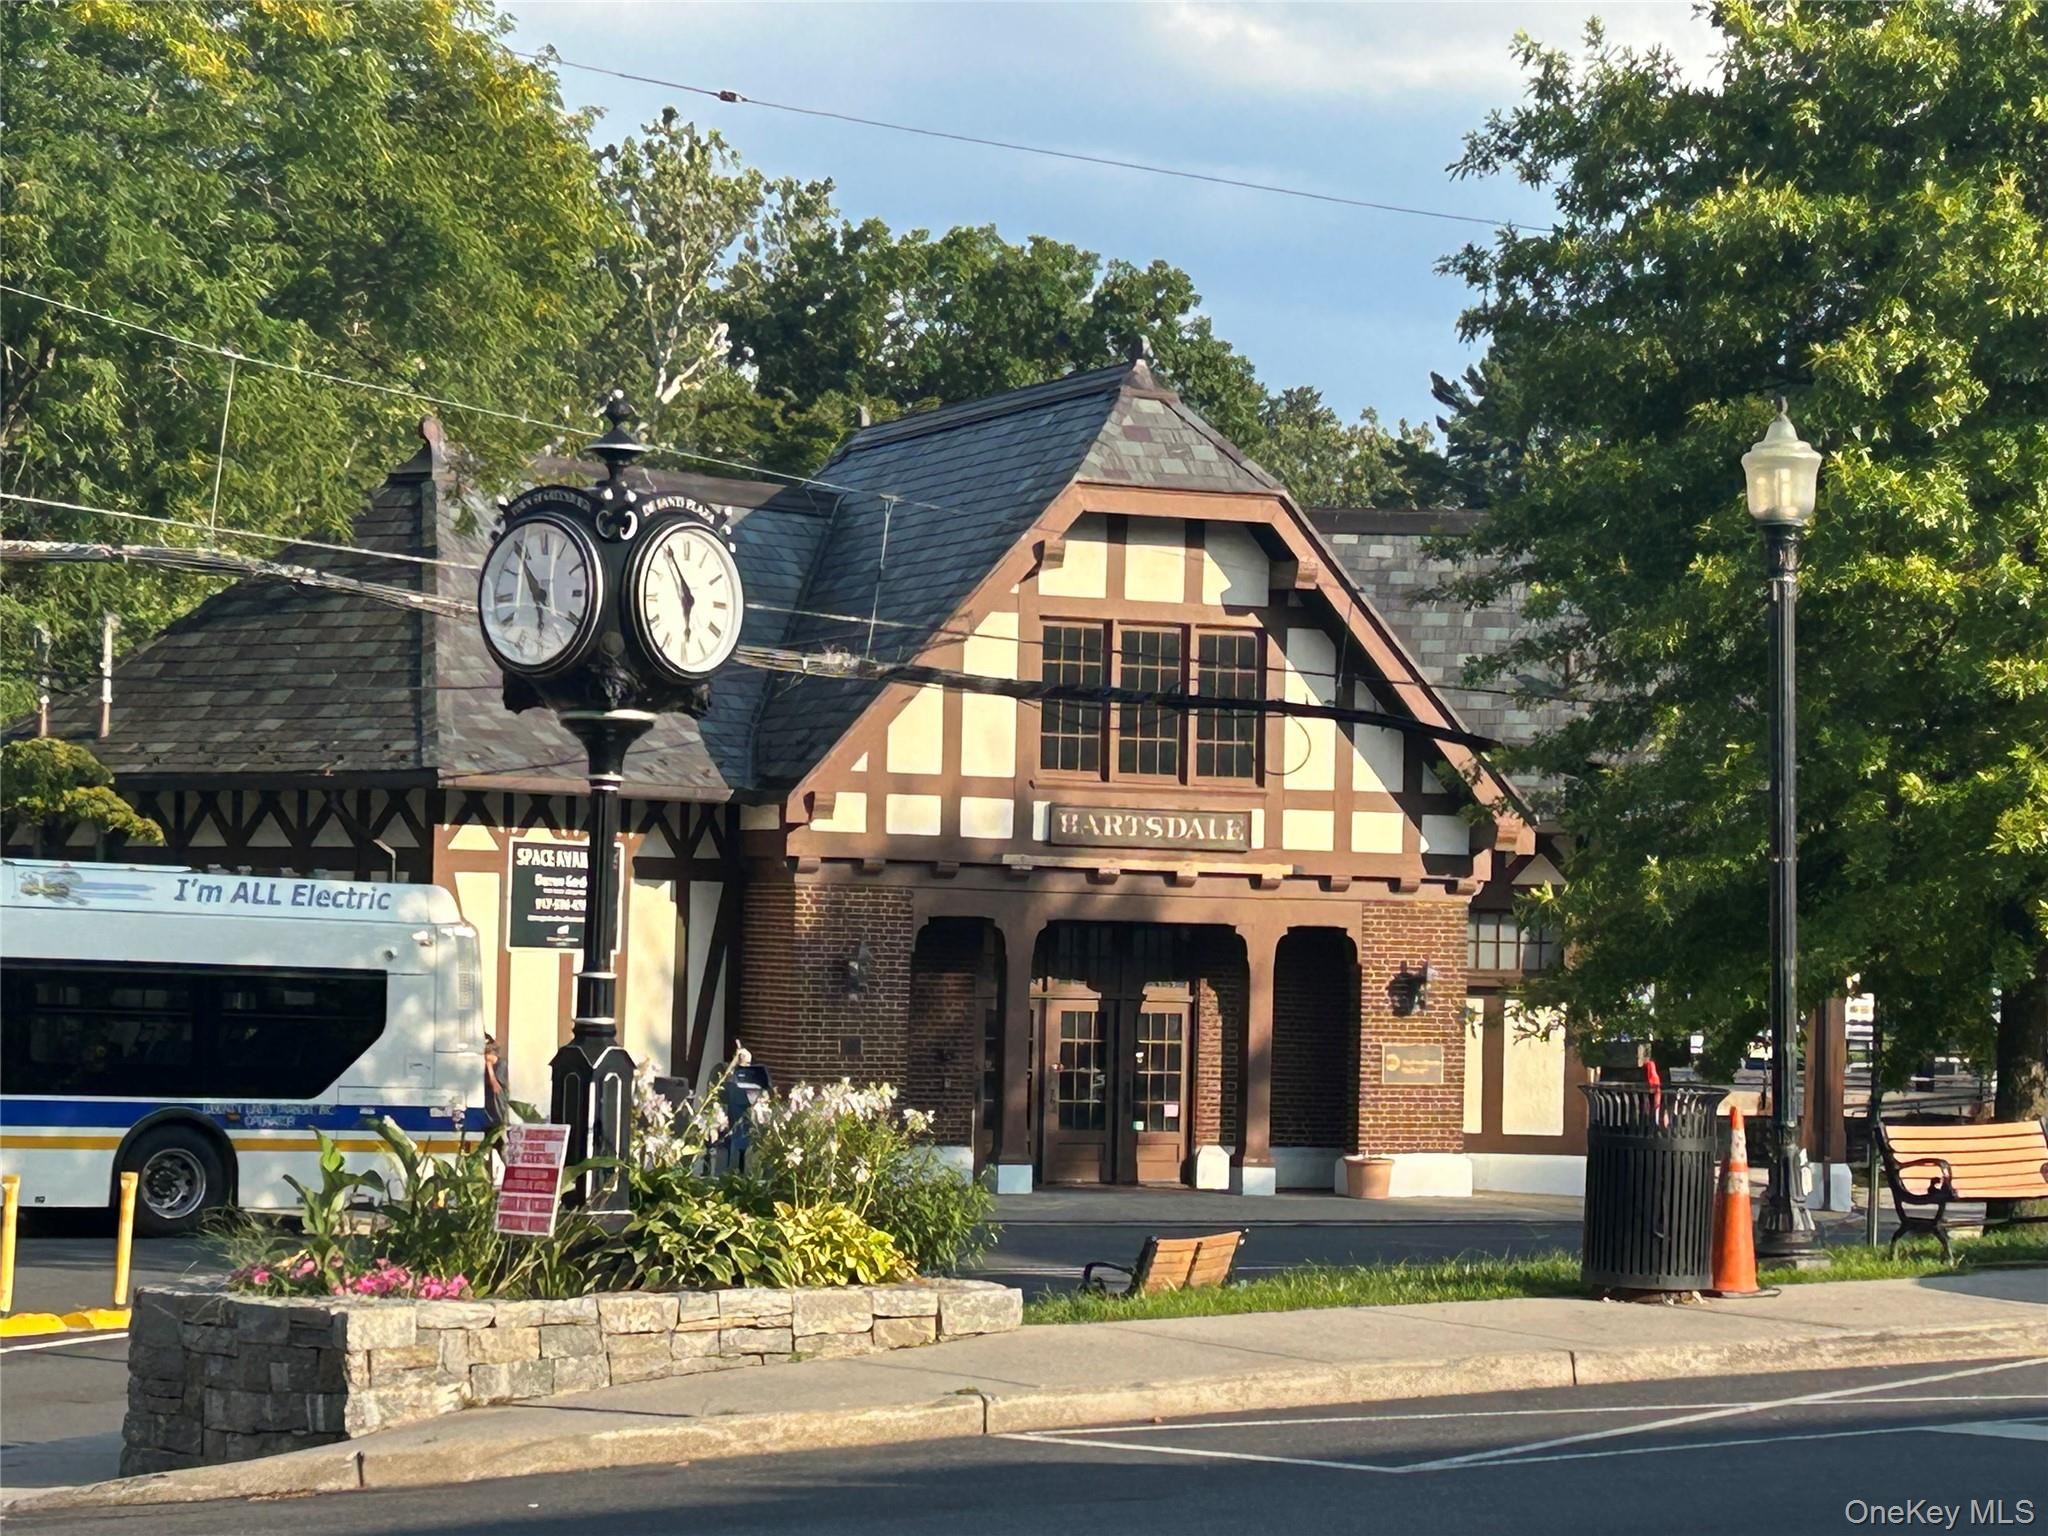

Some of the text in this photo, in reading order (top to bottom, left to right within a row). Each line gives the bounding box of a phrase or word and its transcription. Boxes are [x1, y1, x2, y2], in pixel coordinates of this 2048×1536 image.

[1059, 813, 1245, 841] HARTSDALE
[516, 848, 555, 867] SPACE
[174, 878, 392, 910] I'm ALL Electric
